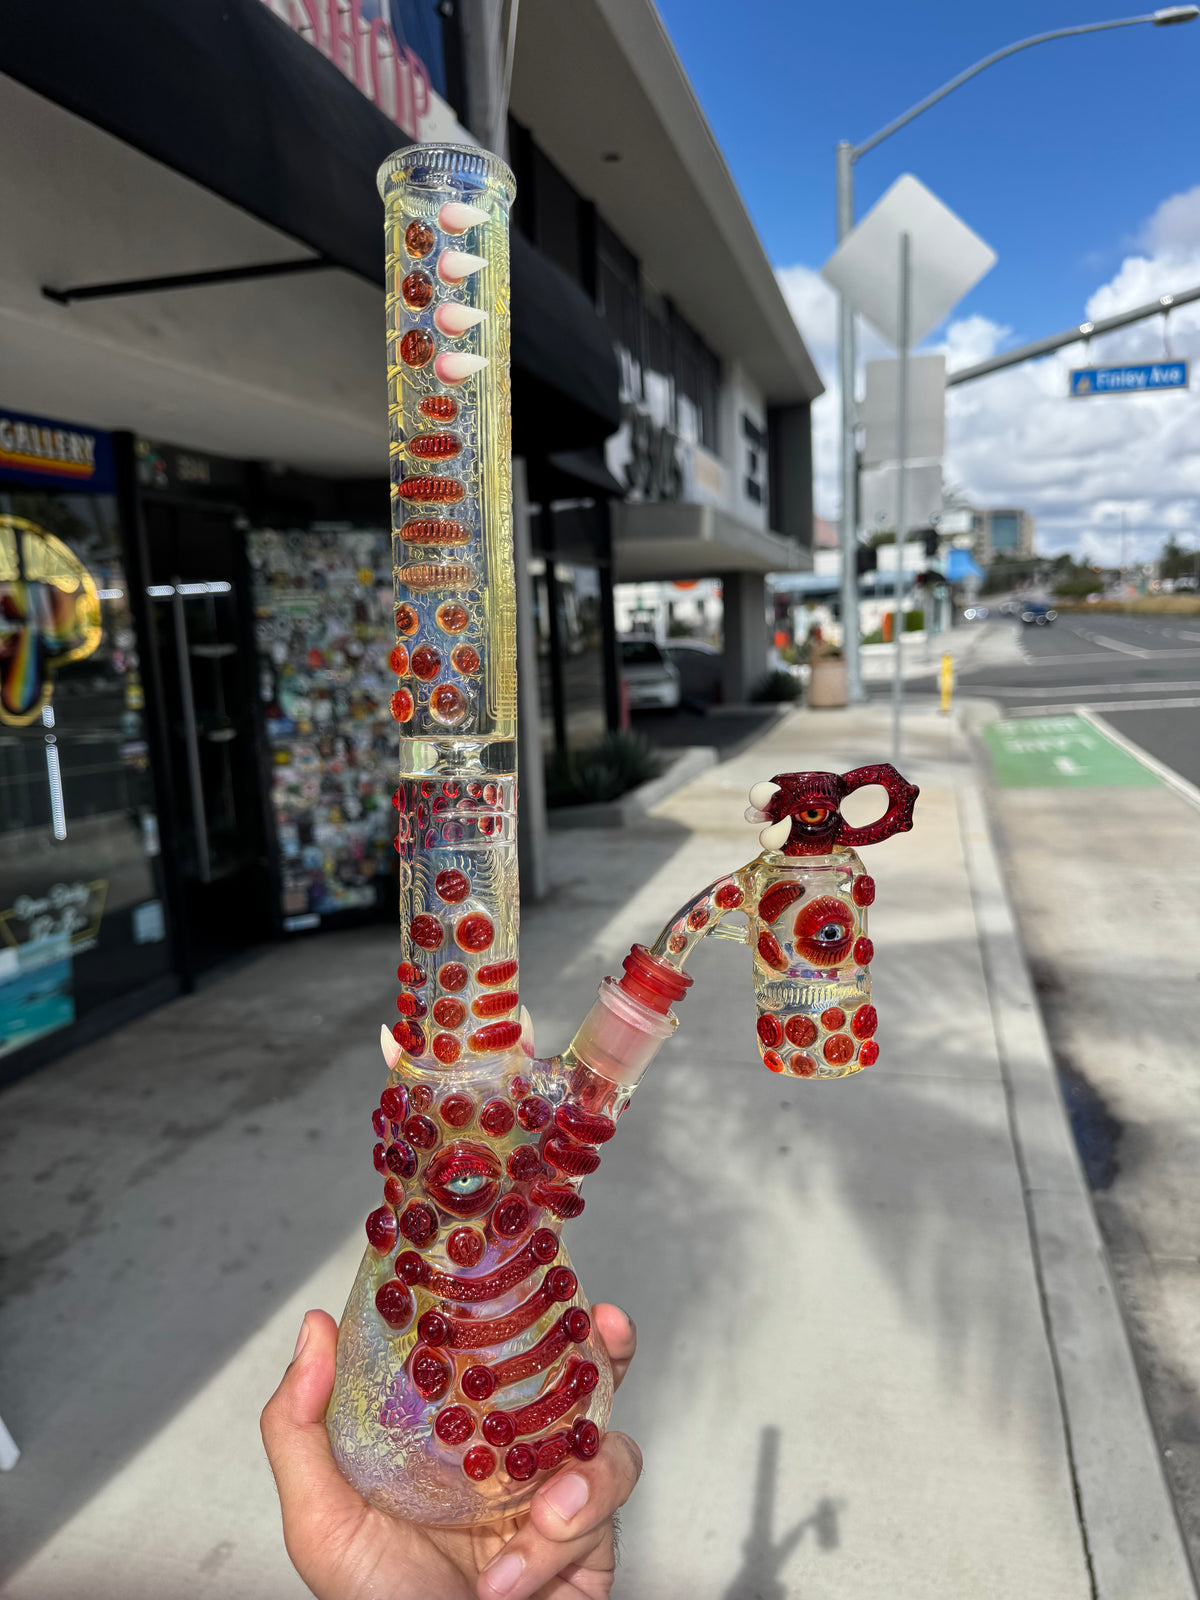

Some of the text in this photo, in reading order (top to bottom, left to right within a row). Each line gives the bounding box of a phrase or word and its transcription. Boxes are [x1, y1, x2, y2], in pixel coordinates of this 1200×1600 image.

[1097, 366, 1181, 389] Finley Ave
[0, 419, 96, 464] GALLERY
